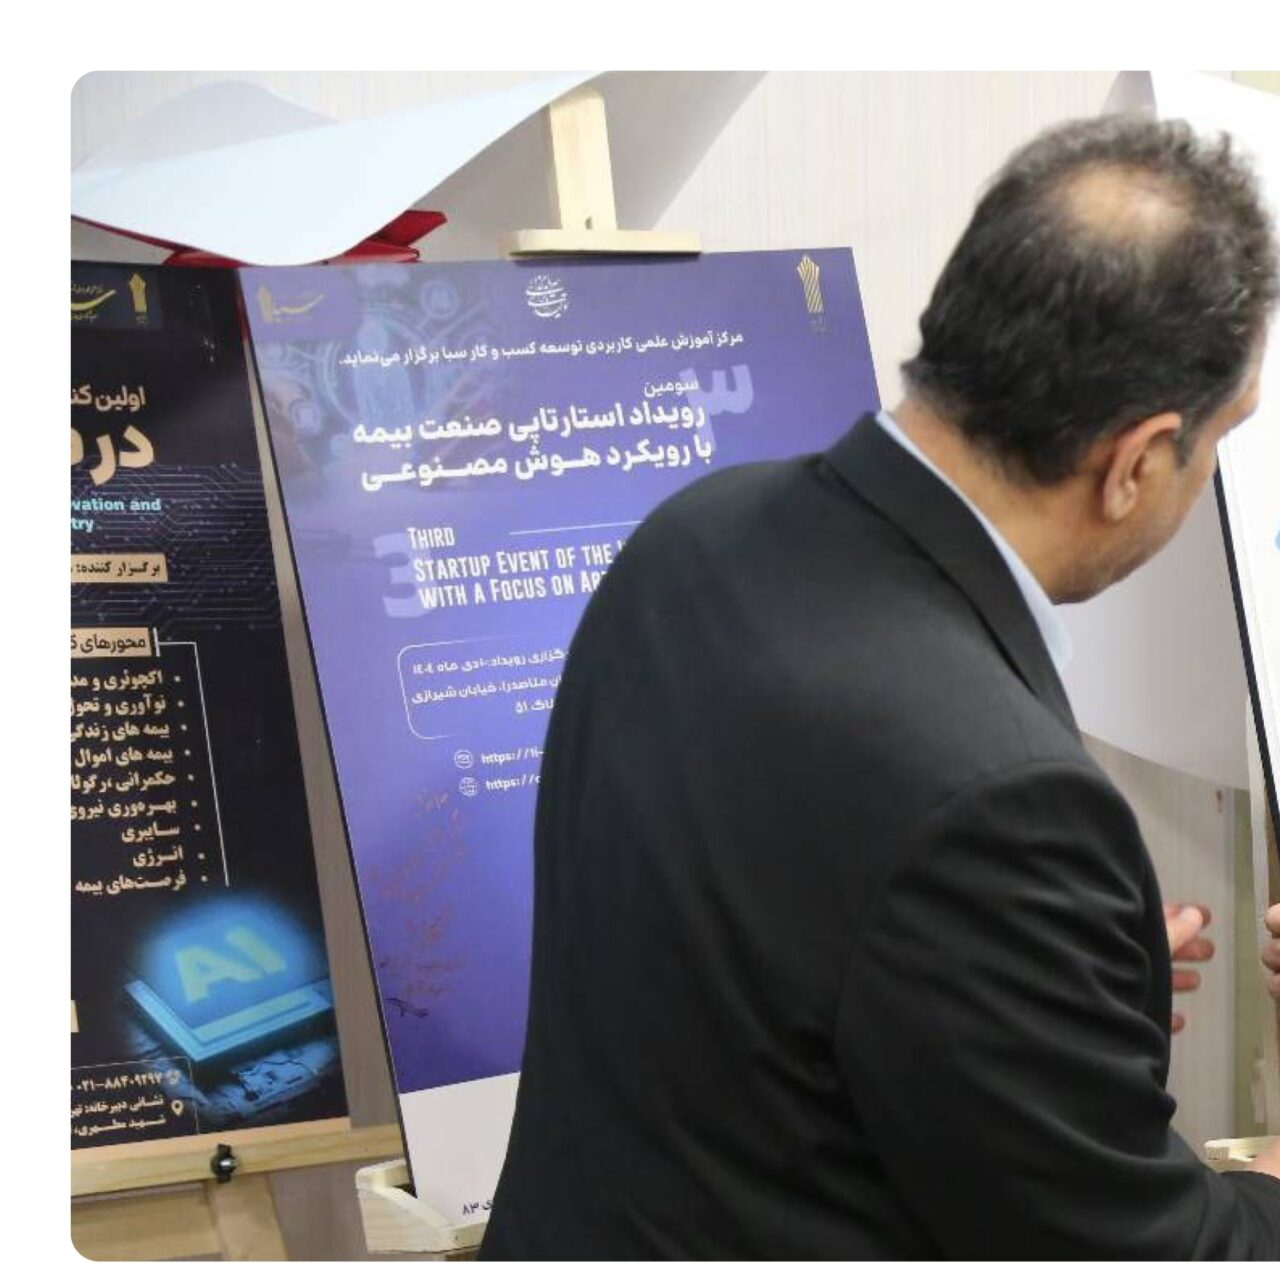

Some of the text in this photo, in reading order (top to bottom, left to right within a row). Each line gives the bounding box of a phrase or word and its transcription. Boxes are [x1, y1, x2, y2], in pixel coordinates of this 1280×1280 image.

[501, 342, 536, 356] کسب
[538, 340, 582, 356] توسعه
[585, 336, 633, 355] کاربردی
[635, 335, 668, 353] علمی
[671, 331, 714, 350] آموزش
[717, 331, 744, 348] مرکز
[404, 345, 440, 365] برگزار
[469, 344, 488, 361] کار
[644, 378, 699, 397] سومین
[95, 384, 147, 413] اولین
[353, 400, 706, 449] رویداد استارتاپی صنعت بیمه
[361, 433, 712, 492] با رویکرد هوش مصنوعی
[130, 498, 161, 511] and
[117, 562, 160, 576] برگزار
[413, 558, 491, 583] STARTUP
[496, 549, 549, 575] EVENT
[557, 547, 576, 569] OF
[584, 543, 614, 565] THE
[418, 584, 468, 610] WITH
[474, 582, 487, 604] A
[490, 576, 547, 602] FOCUS
[553, 573, 575, 596] ON
[80, 635, 146, 653] محورهای
[92, 677, 100, 691] و
[459, 682, 497, 698] خیابان
[104, 703, 112, 717] و
[112, 721, 140, 741] های
[143, 724, 170, 738] بیمه
[75, 747, 173, 768] بیمه های اموال
[121, 821, 180, 843] سایبری
[133, 845, 183, 867] انرژی
[75, 880, 103, 895] بیمه
[174, 924, 288, 1003] AI
